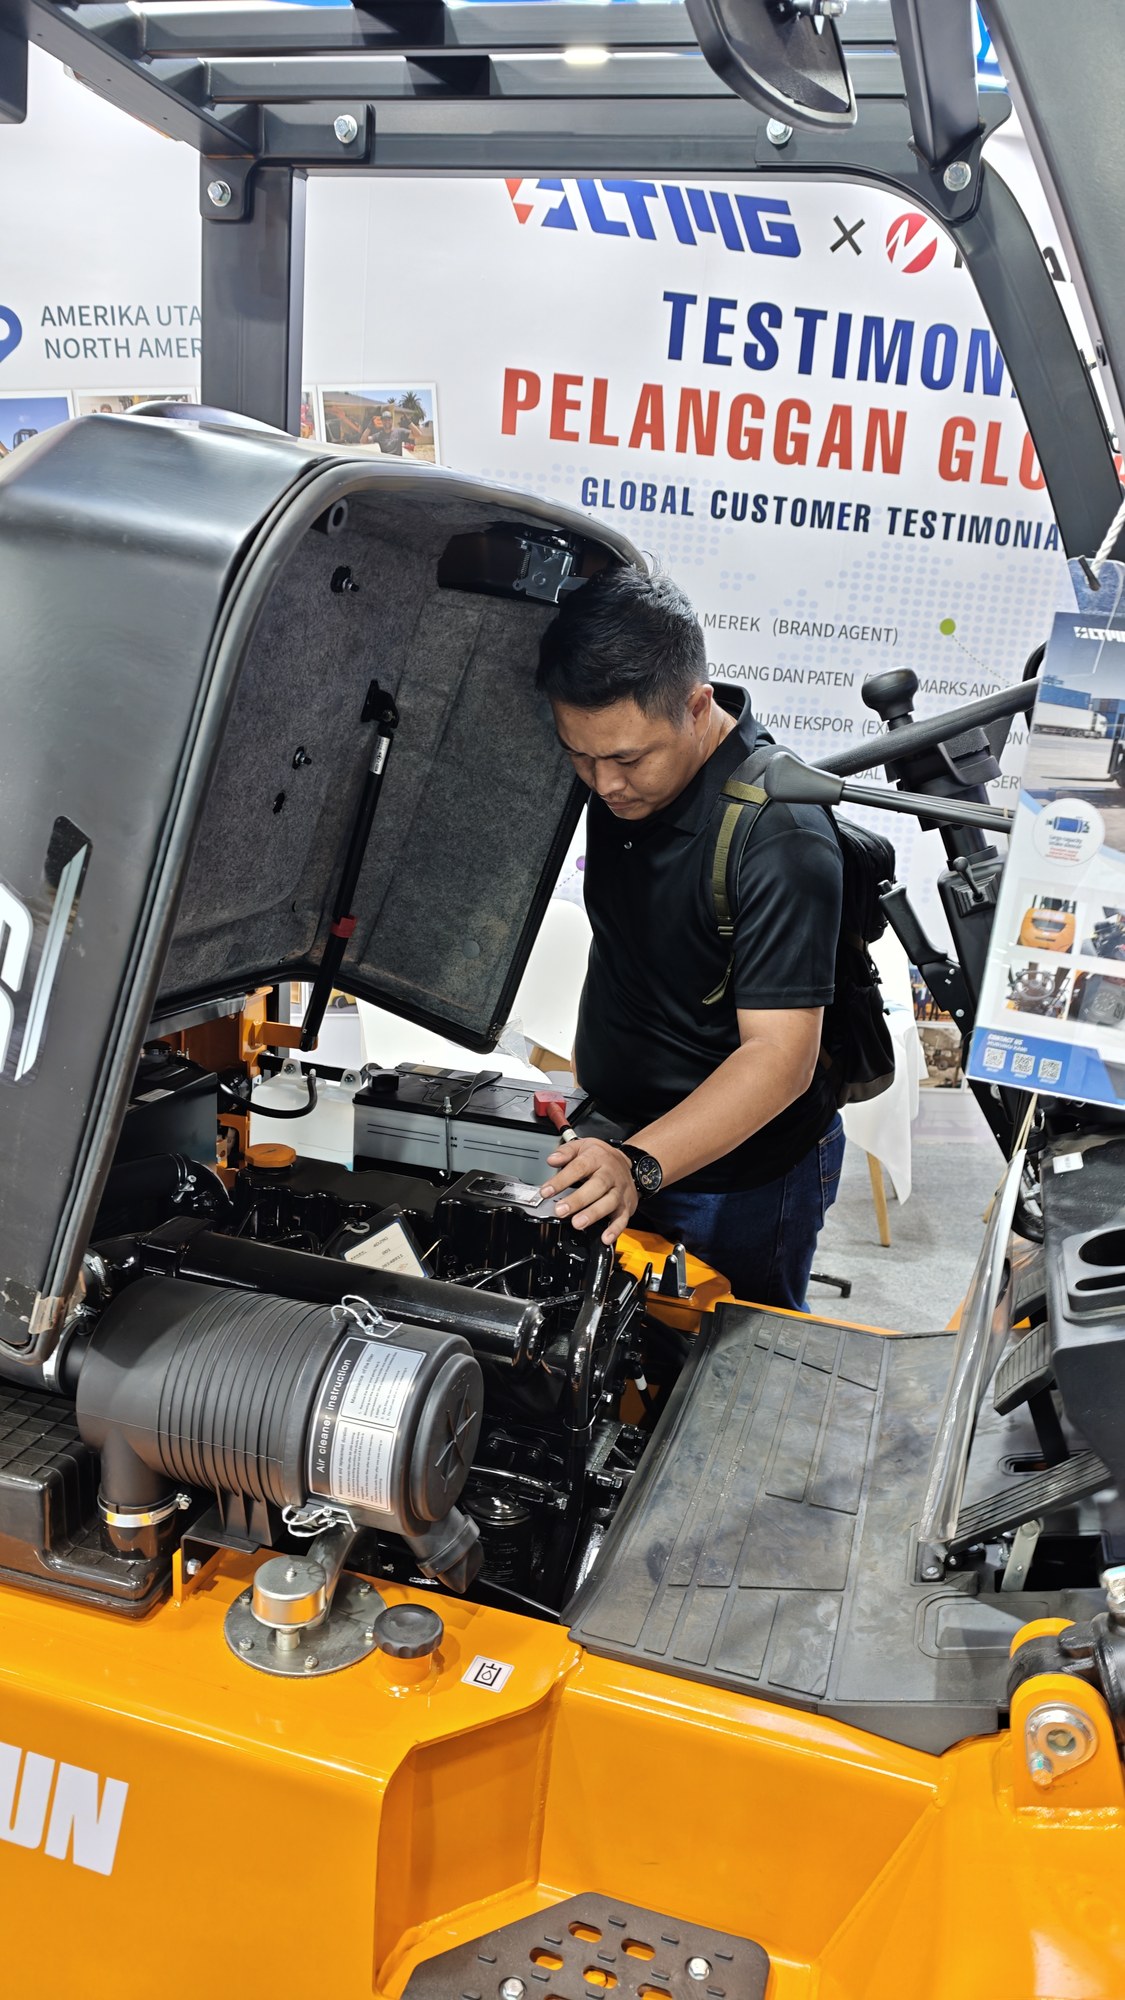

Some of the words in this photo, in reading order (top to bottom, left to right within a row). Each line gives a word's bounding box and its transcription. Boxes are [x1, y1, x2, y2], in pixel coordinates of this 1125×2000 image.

[41, 305, 149, 326] AMERIKA
[156, 305, 202, 326] UTA
[45, 337, 131, 359] NORTH
[662, 290, 1018, 399] TESTIMON
[501, 367, 907, 475] PELANGGAN
[581, 476, 695, 517] GLOBAL
[710, 489, 871, 534] CUSTOMER
[886, 507, 1060, 552] TESTIMONIA
[704, 613, 761, 632] MEREK
[773, 617, 835, 638] (BRAND
[838, 625, 898, 646] AGENT)
[707, 662, 769, 681] DAGANG
[773, 667, 804, 684] DAN
[808, 671, 854, 687] PATEN
[794, 715, 854, 733] EKSPOR
[862, 718, 889, 736] (EX
[991, 775, 1021, 789] SER
[325, 1359, 352, 1411] instruction
[319, 1414, 331, 1453] cleaner
[316, 1458, 326, 1473] Air
